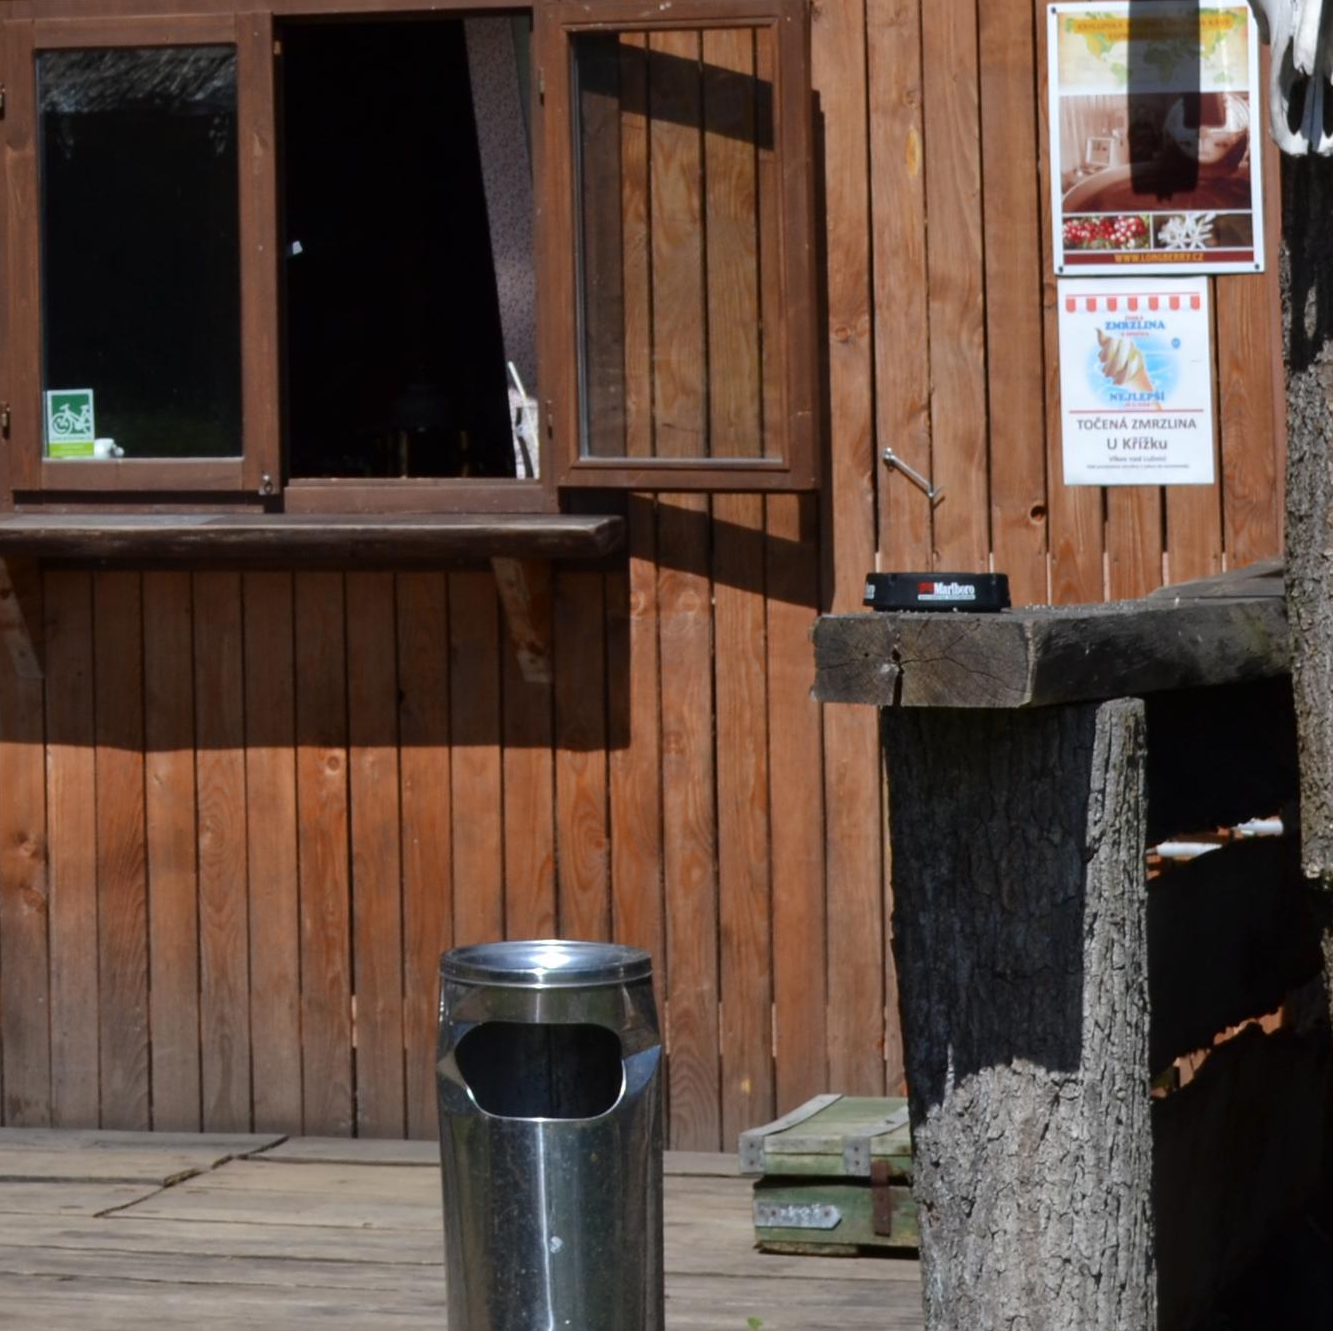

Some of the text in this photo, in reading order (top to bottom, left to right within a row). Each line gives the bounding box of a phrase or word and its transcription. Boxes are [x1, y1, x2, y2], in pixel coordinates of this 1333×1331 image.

[1114, 252, 1205, 263] WWW.LONGBERRY.CZ
[1104, 320, 1166, 330] ZMRZLINA
[1109, 390, 1165, 402] NEJLEPŠÍ
[1077, 417, 1197, 430] TOČENÁ ZMRZLINA
[1107, 436, 1168, 450] U Křížku
[933, 582, 976, 595] Marlboro
